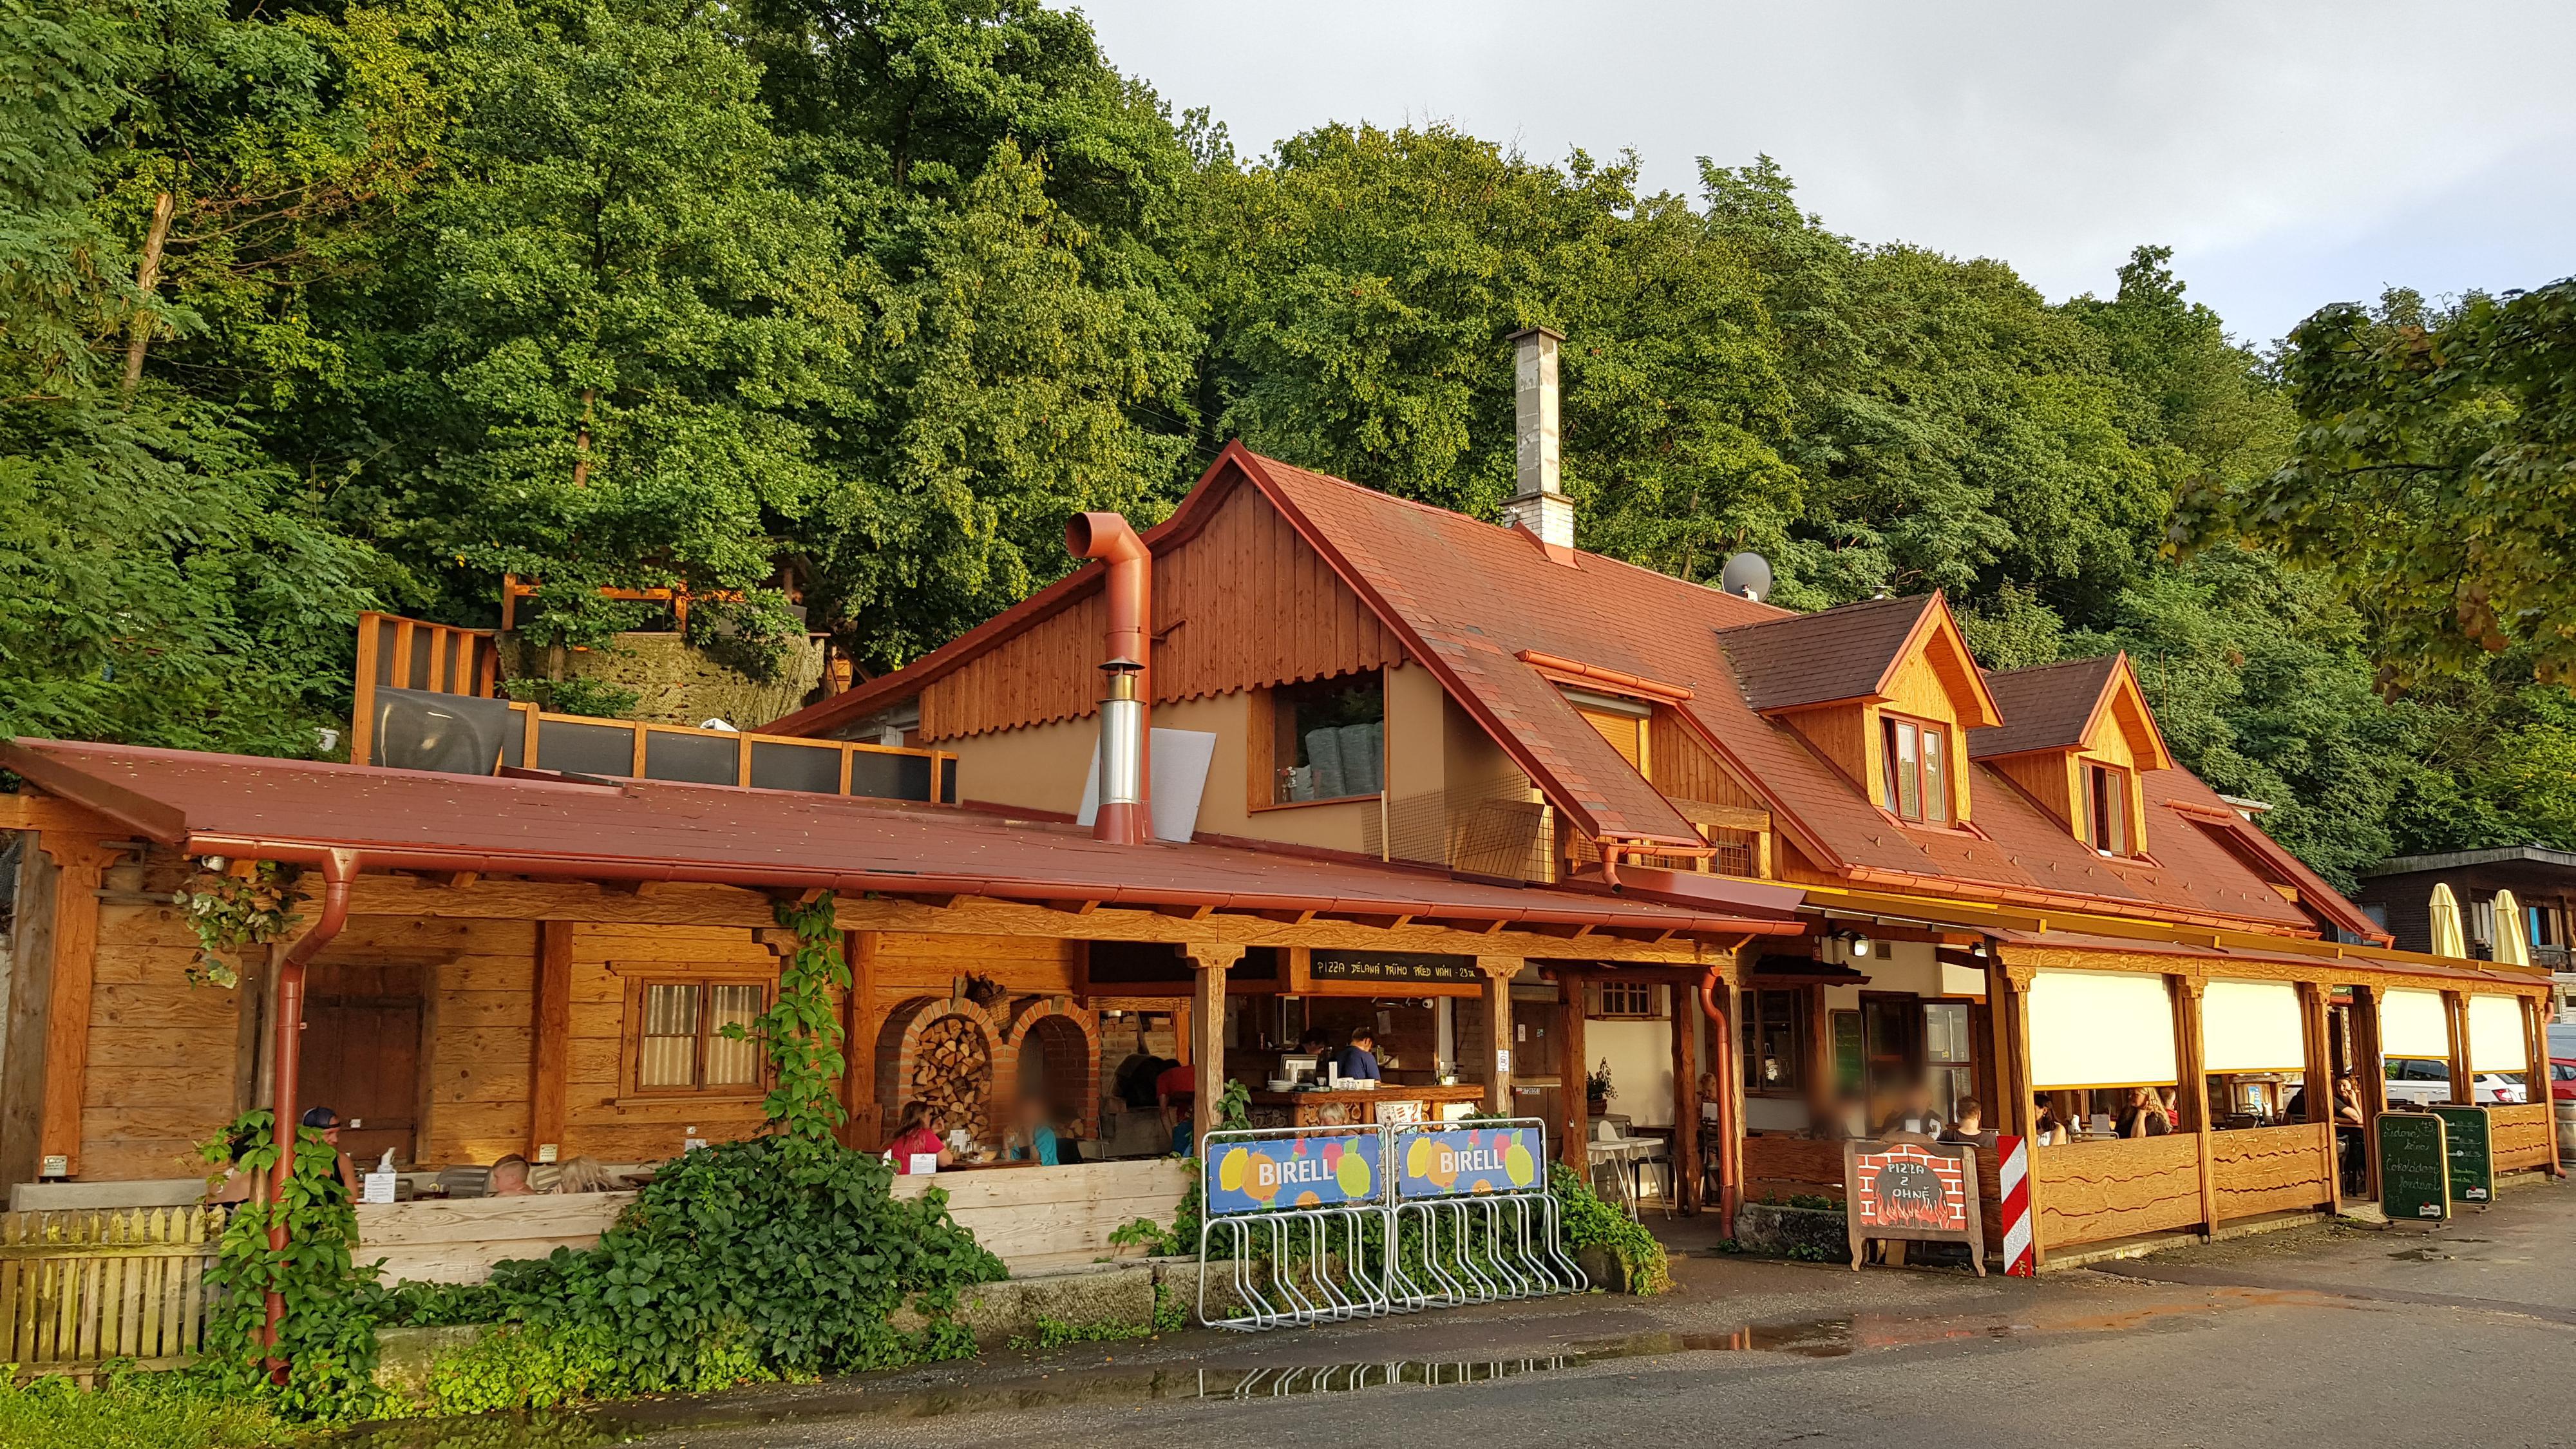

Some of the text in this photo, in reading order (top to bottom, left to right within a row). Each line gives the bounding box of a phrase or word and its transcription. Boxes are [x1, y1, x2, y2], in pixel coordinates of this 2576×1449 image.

[1317, 961, 1345, 974] PIZZA
[1440, 1148, 1504, 1173] BIRELL
[1258, 1159, 1334, 1186] BIRELL
[1888, 1162, 1924, 1175] PIZZA
[1892, 1186, 1930, 1198] OHNĚ
